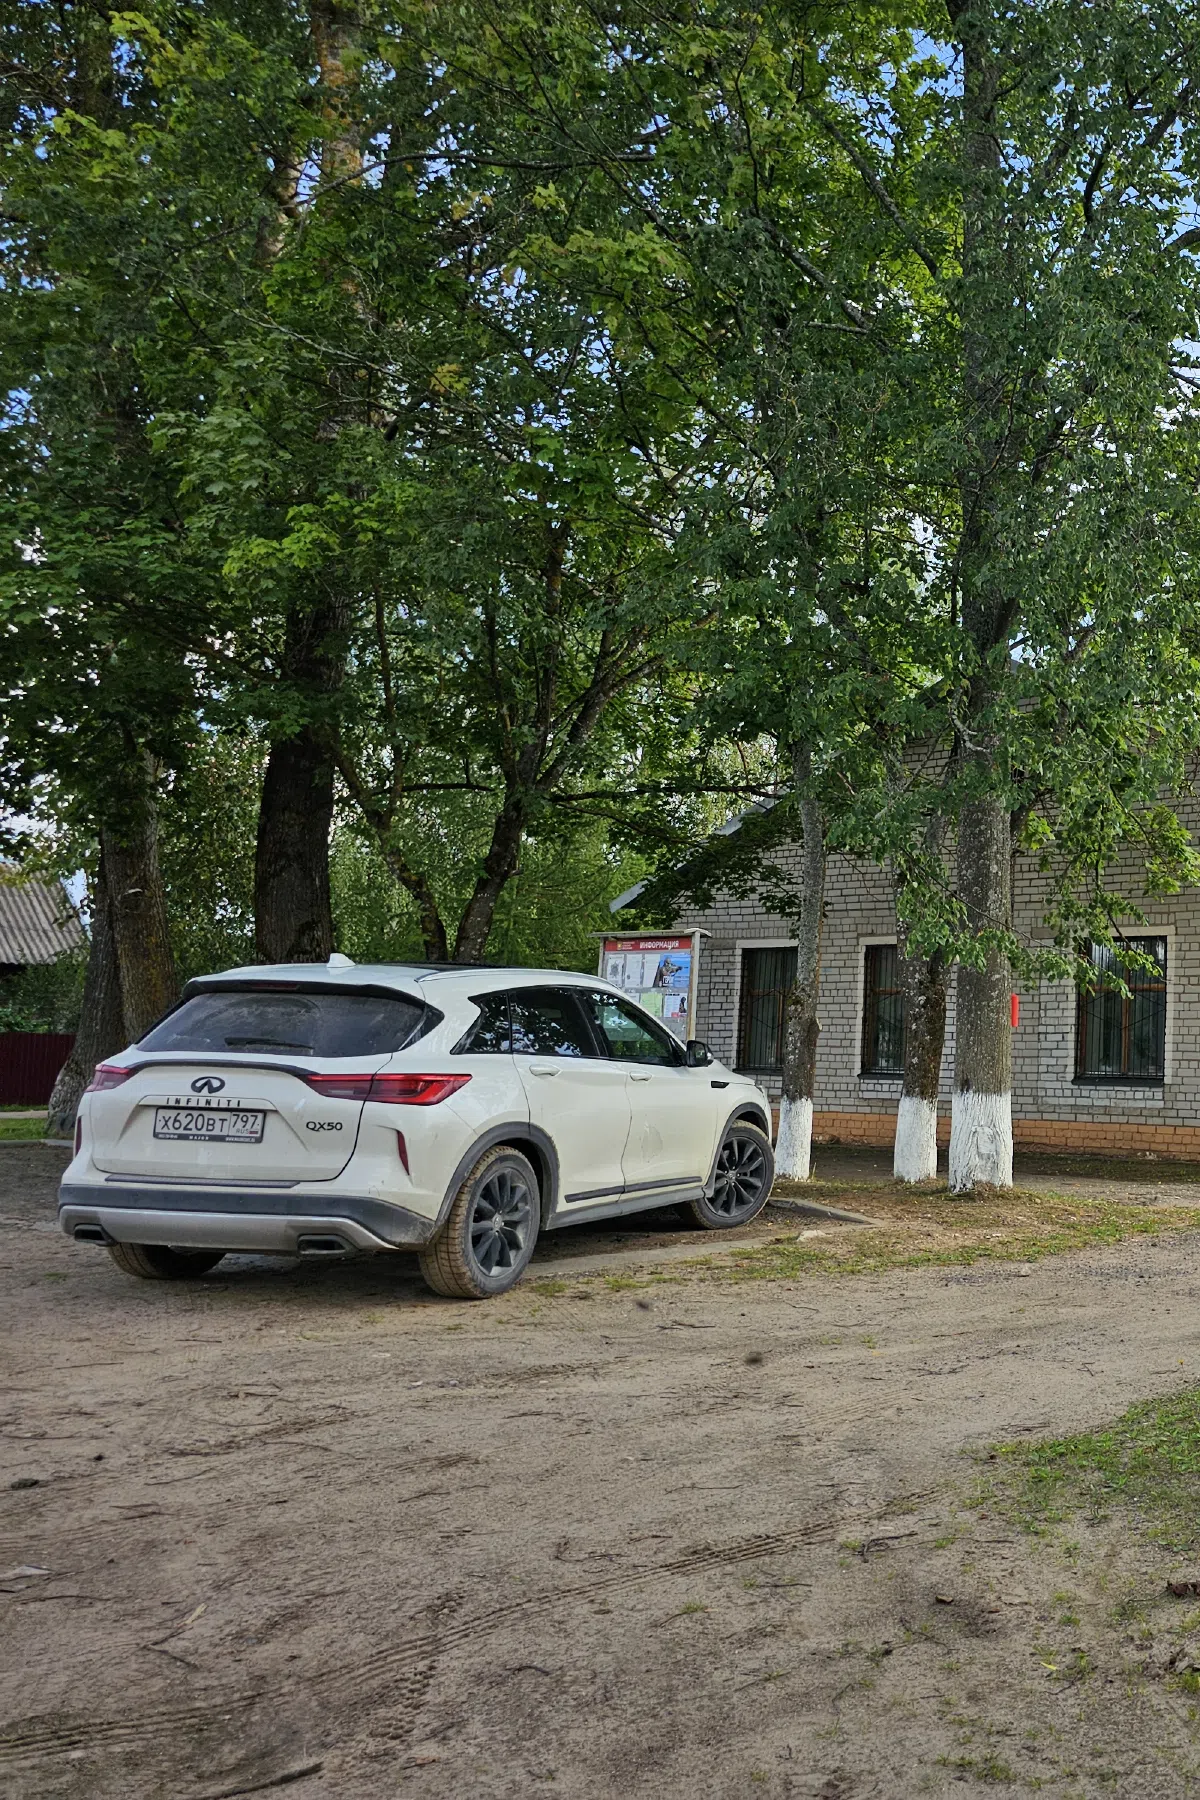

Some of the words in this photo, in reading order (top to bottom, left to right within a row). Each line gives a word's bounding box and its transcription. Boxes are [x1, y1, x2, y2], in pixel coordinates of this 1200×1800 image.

[640, 940, 679, 950] ИНФОРМАЦИЯ
[166, 1097, 241, 1107] INFINITI
[232, 1113, 259, 1129] 797
[305, 1120, 343, 1132] QX50
